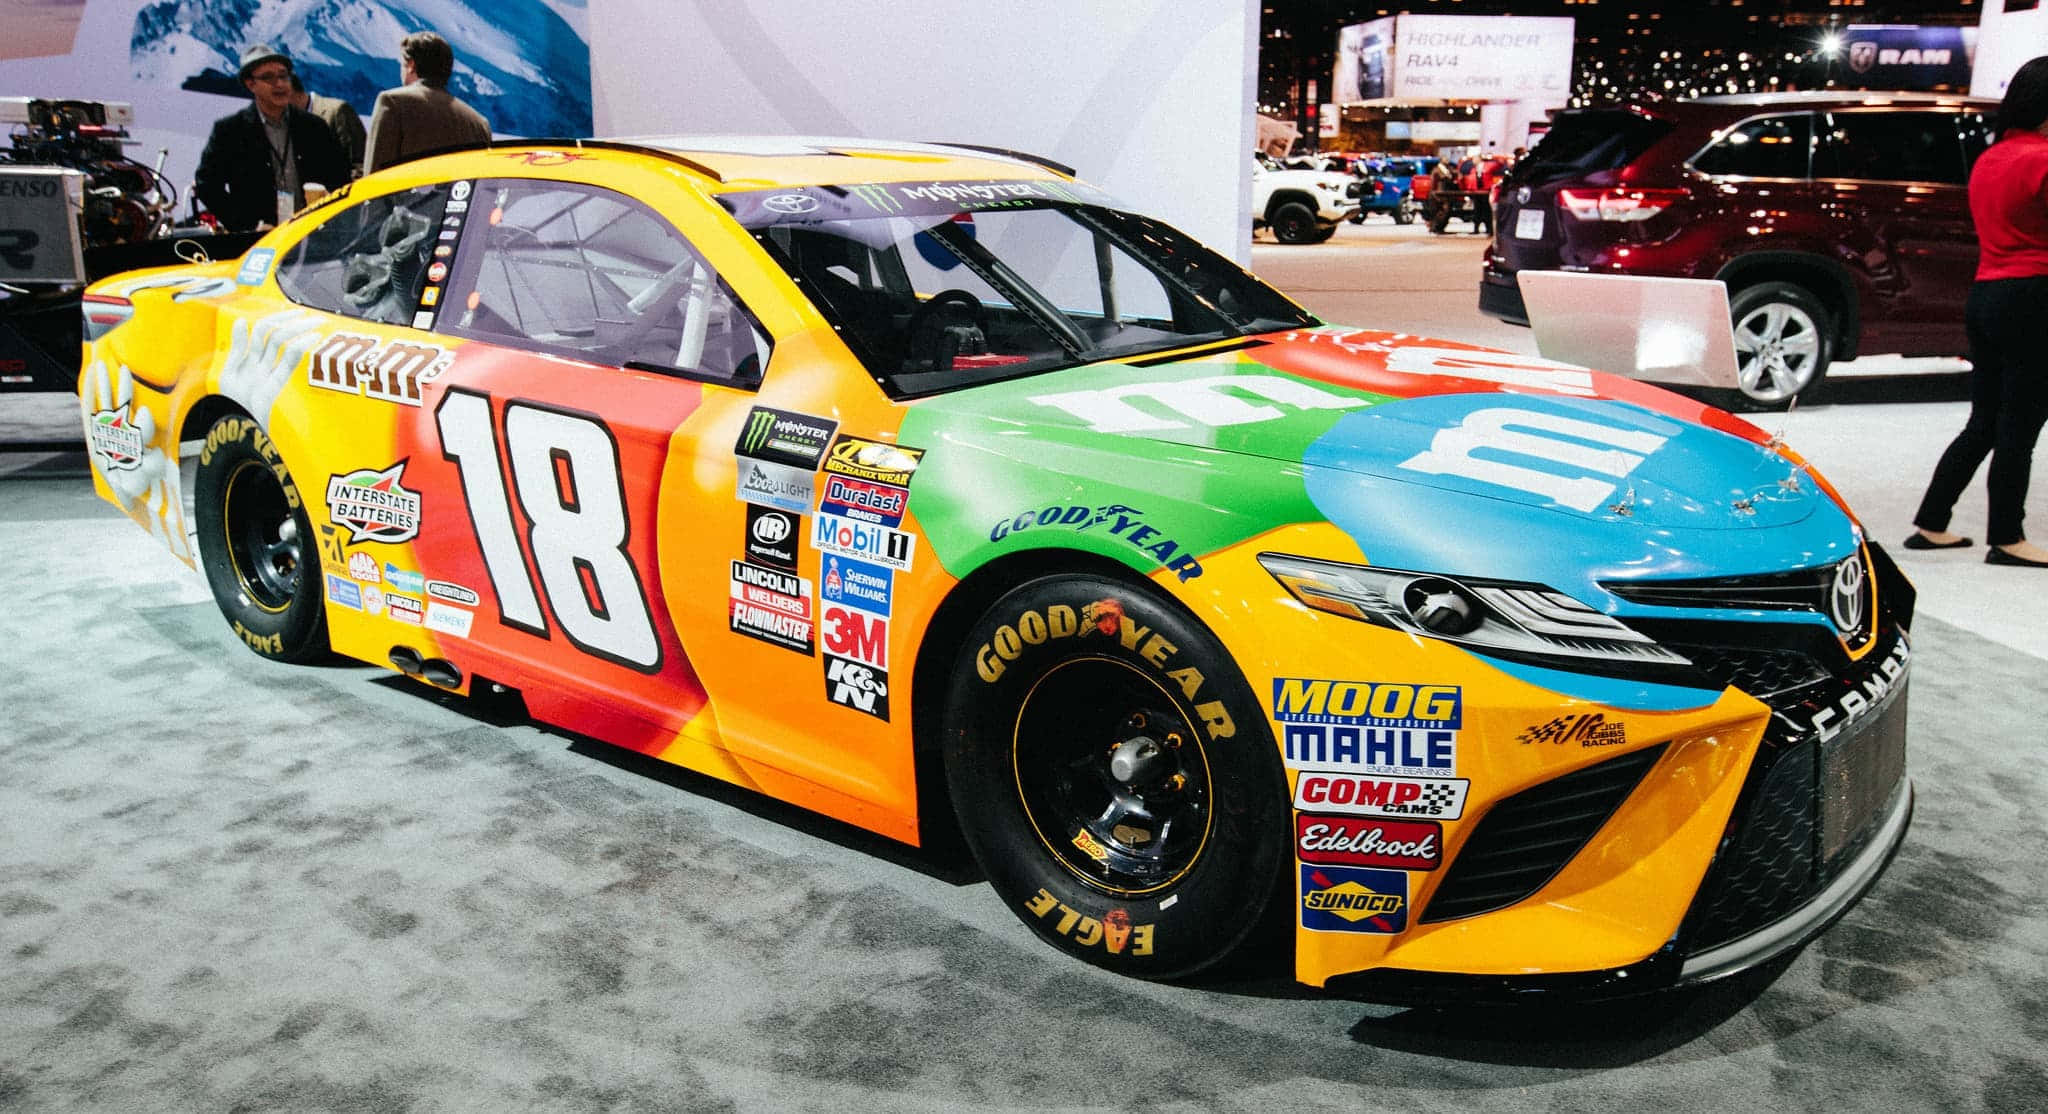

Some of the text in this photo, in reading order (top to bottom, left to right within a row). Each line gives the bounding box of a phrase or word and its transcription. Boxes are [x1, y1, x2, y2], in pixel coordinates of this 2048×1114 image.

[1407, 32, 1541, 48] HIGHLANDER
[1406, 54, 1459, 67] RAV4
[1878, 49, 1950, 64] RAM
[900, 182, 1046, 201] MONSTER
[775, 421, 829, 441] MONSTER
[825, 459, 909, 485] MECHANIX WEAR
[334, 485, 415, 513] INTERSTATE
[830, 482, 902, 512] Duralast
[337, 503, 413, 529] BATTERIES
[847, 508, 884, 524] BRAKES
[434, 384, 664, 675] 18
[818, 516, 882, 555] Mobil
[734, 563, 798, 596] LINCOLN
[845, 568, 888, 590] SHERWIN
[749, 586, 804, 613] WELDERS
[733, 602, 809, 643] FLOWMASTER
[824, 608, 886, 667] 3M
[1277, 679, 1457, 720] MOOG
[1284, 713, 1342, 724] STEERING
[1366, 717, 1444, 729] SUSPENSION
[1600, 722, 1625, 731] JOE
[1285, 725, 1452, 768] MAHLE
[1582, 737, 1626, 748] RACING
[1591, 730, 1625, 739] GIBBS
[1367, 763, 1452, 777] ENGINE BEARINGS
[1302, 777, 1421, 806] COMP
[1381, 803, 1443, 815] CAMS
[1300, 824, 1436, 859] Edelbrock
[1307, 892, 1400, 913] SUNOCO
[1024, 887, 1155, 956] EAGLE
